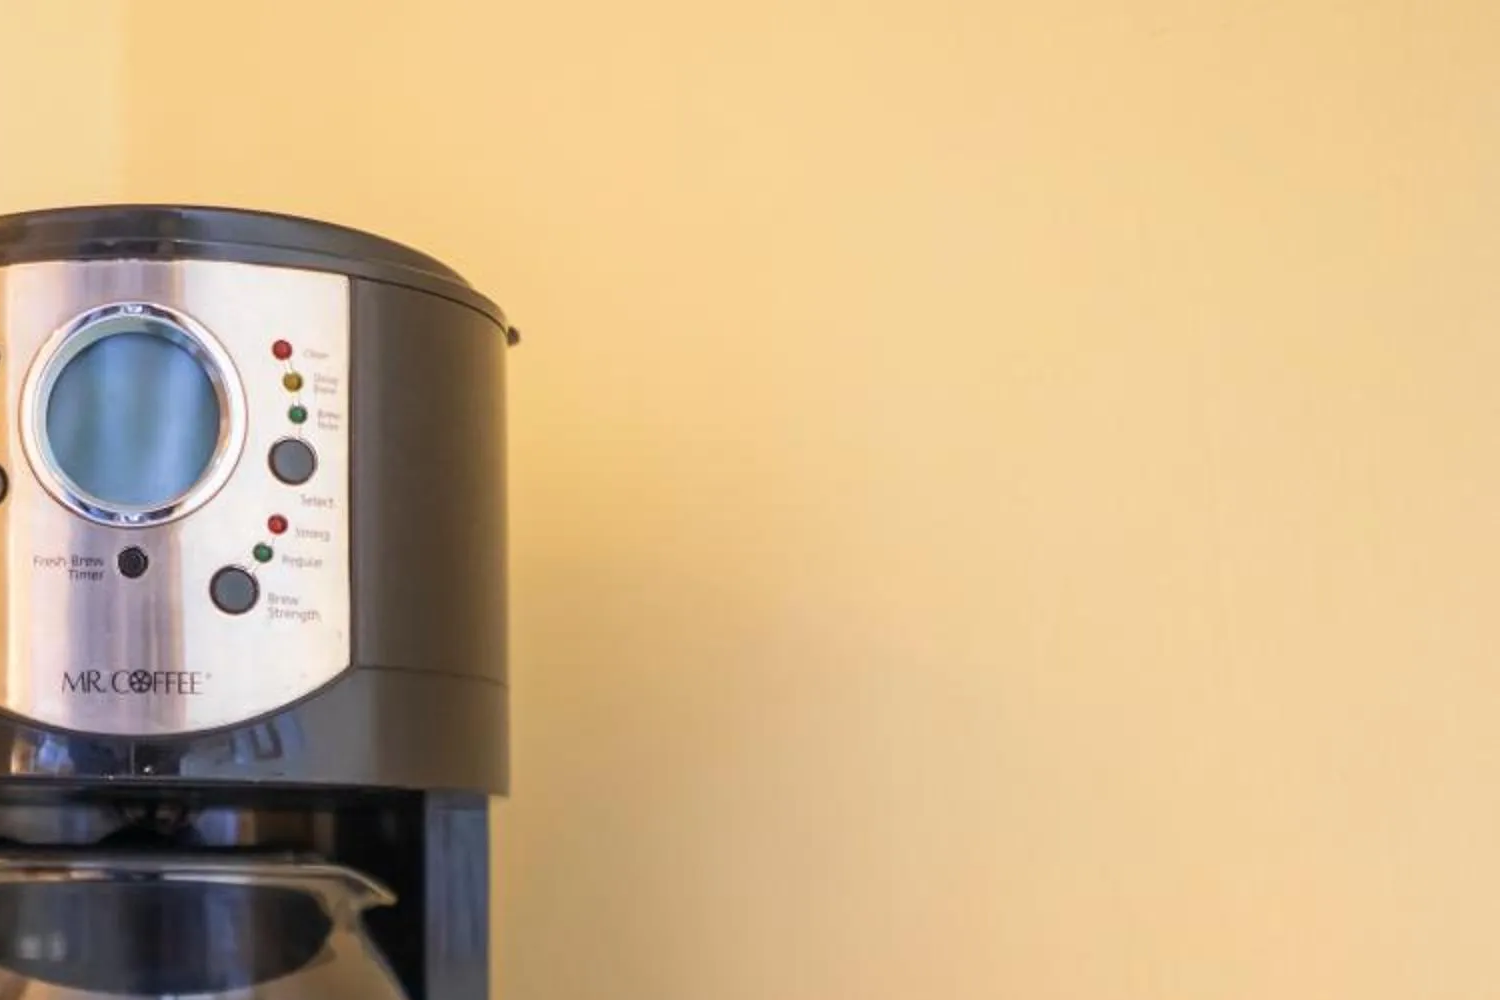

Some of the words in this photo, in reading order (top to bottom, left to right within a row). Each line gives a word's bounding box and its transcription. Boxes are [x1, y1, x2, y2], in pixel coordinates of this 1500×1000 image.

[68, 568, 104, 581] Timer
[267, 592, 299, 605] Brew
[267, 606, 322, 623] Strength
[111, 669, 204, 695] COFFEE
